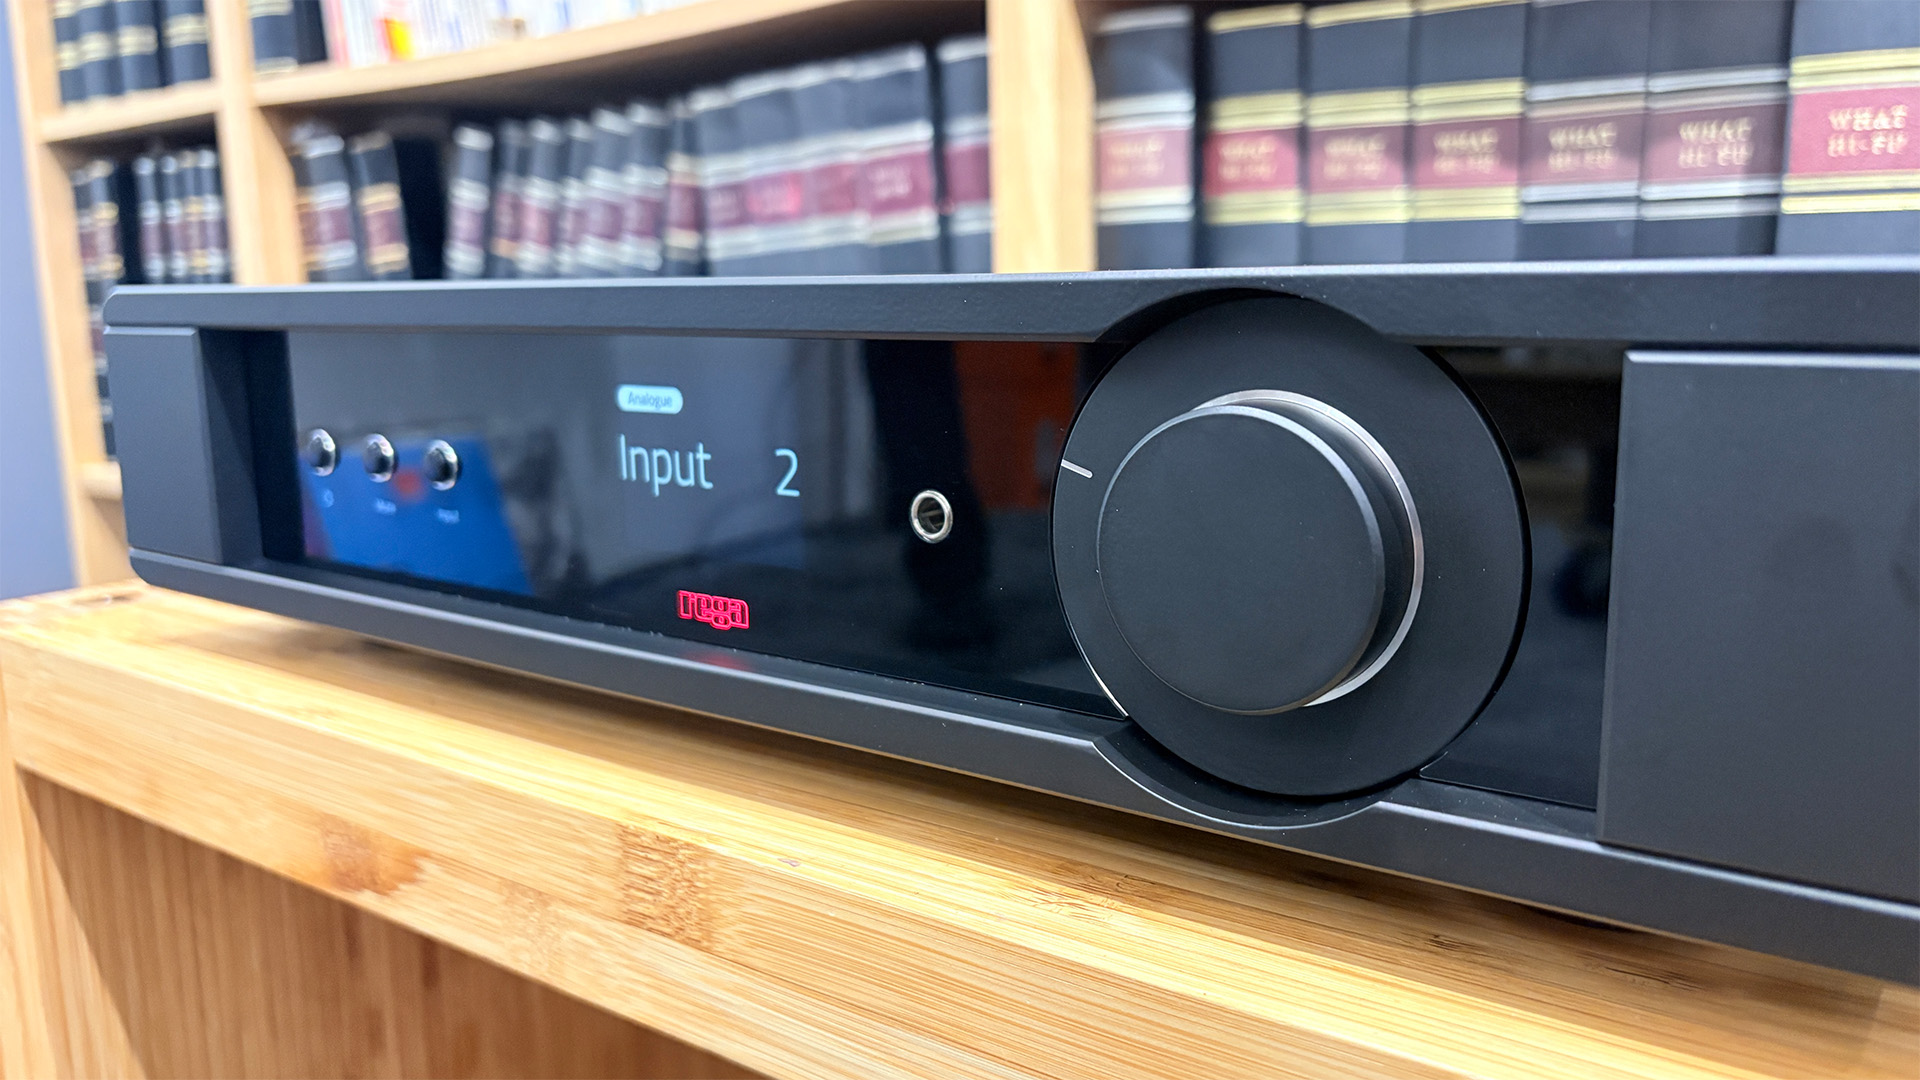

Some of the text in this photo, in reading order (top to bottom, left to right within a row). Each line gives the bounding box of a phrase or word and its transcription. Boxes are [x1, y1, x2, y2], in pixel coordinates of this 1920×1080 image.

[1828, 105, 1908, 131] WHAT
[627, 391, 673, 409] Analogue
[620, 433, 800, 497] Input 2
[677, 589, 749, 631] rega
